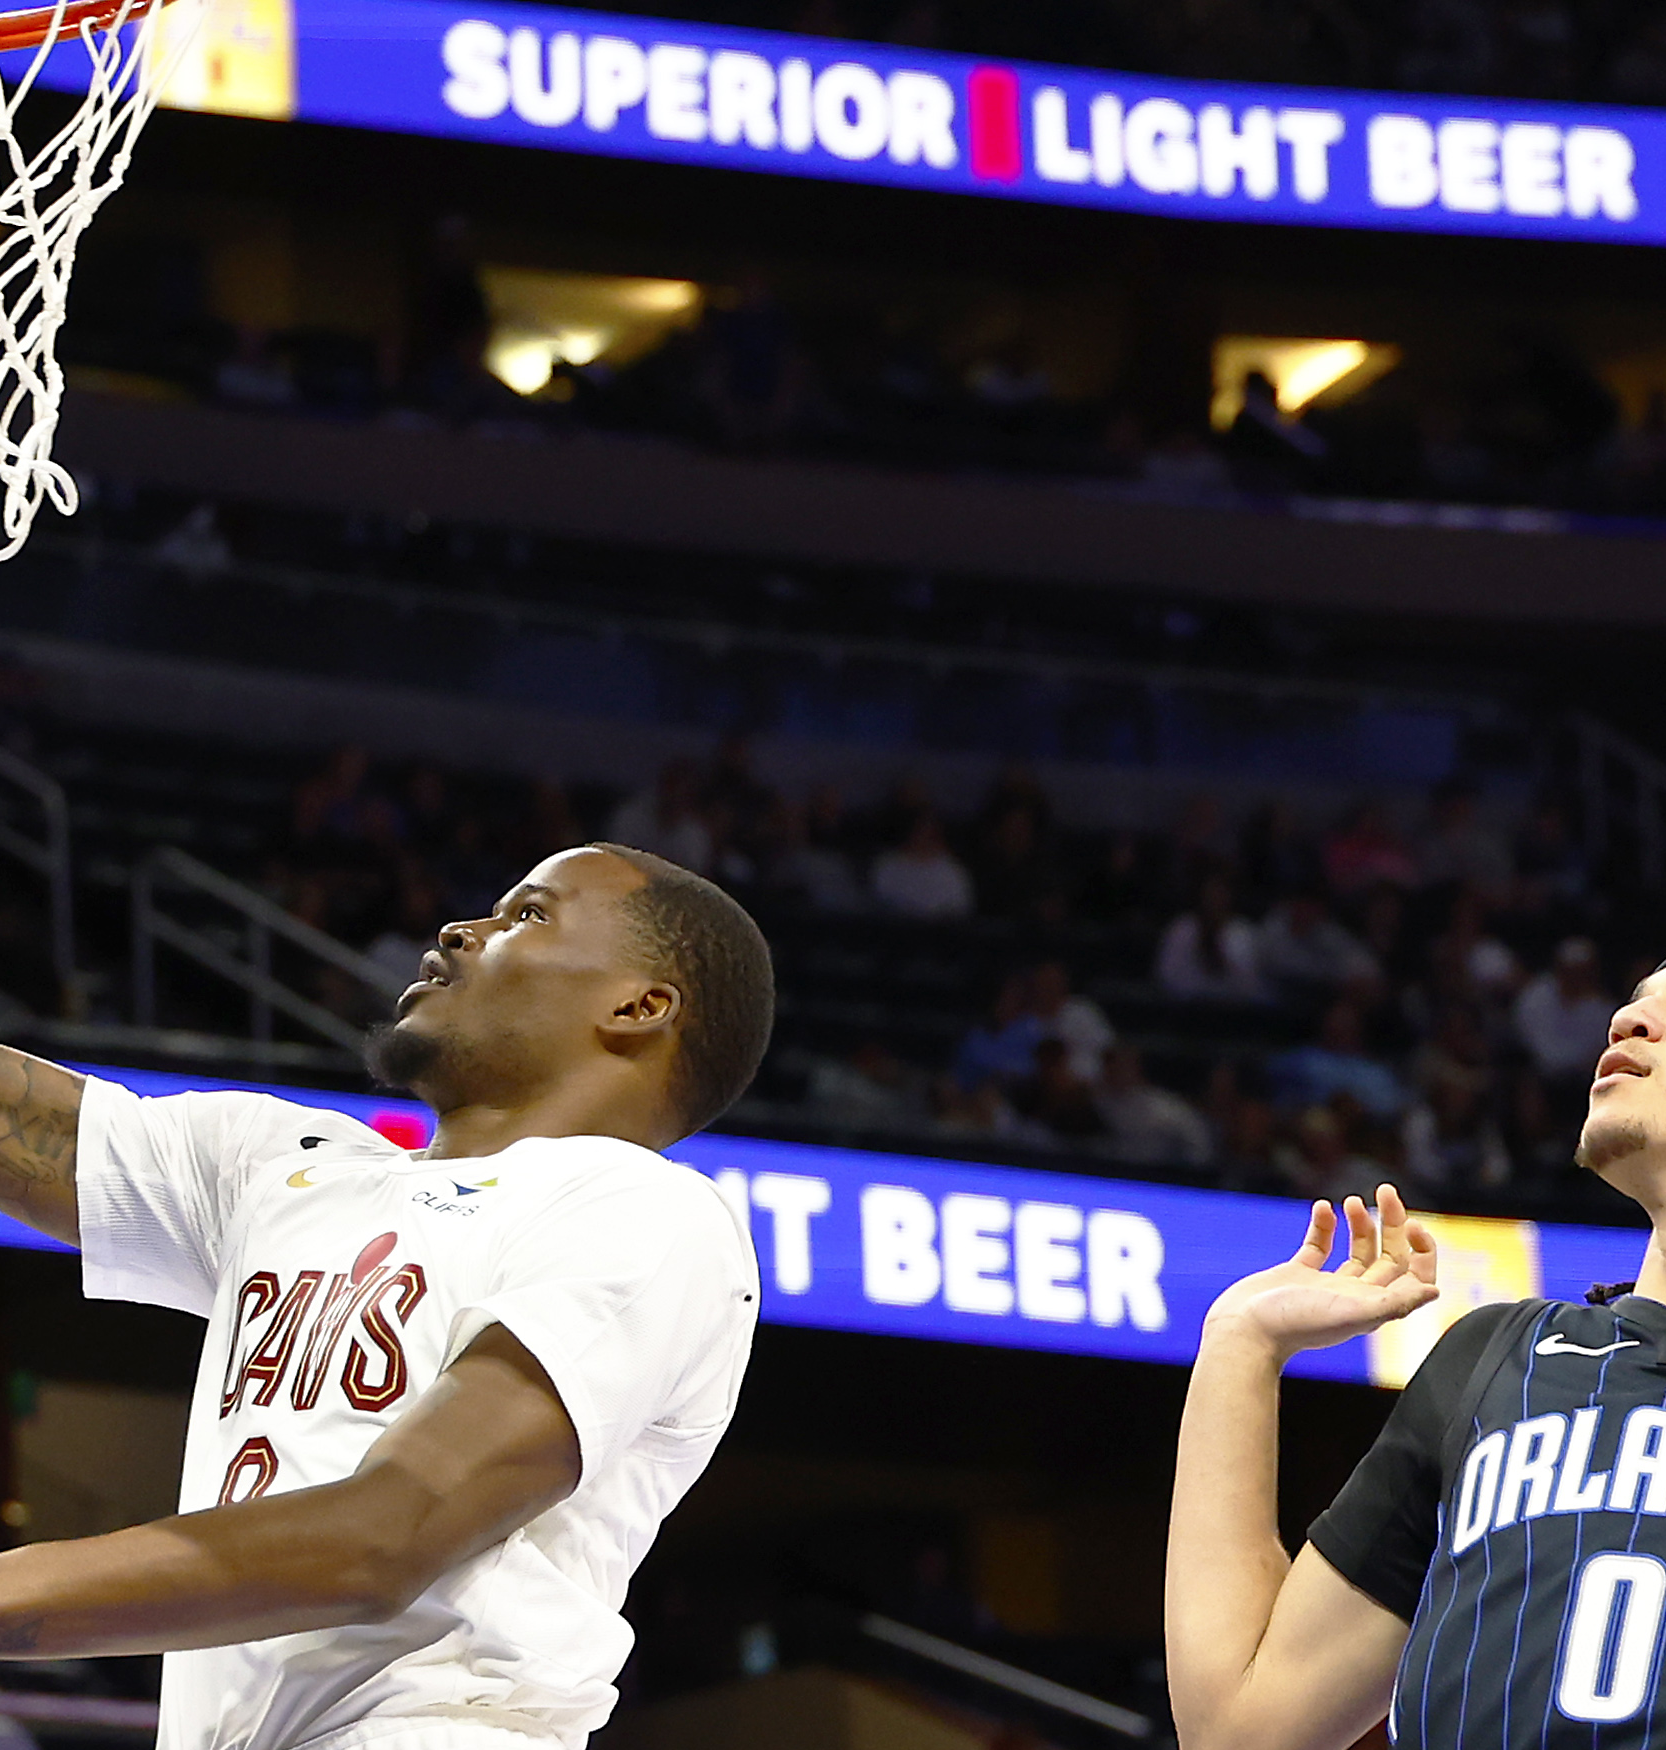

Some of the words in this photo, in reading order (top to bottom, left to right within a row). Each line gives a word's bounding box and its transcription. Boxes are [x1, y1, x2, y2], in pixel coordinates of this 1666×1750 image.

[442, 20, 957, 168] SUPERIOR
[1033, 87, 1346, 203] LIGHT
[1367, 115, 1637, 221] BEER
[859, 1183, 1168, 1332] BEER
[218, 1262, 429, 1421] CAVS
